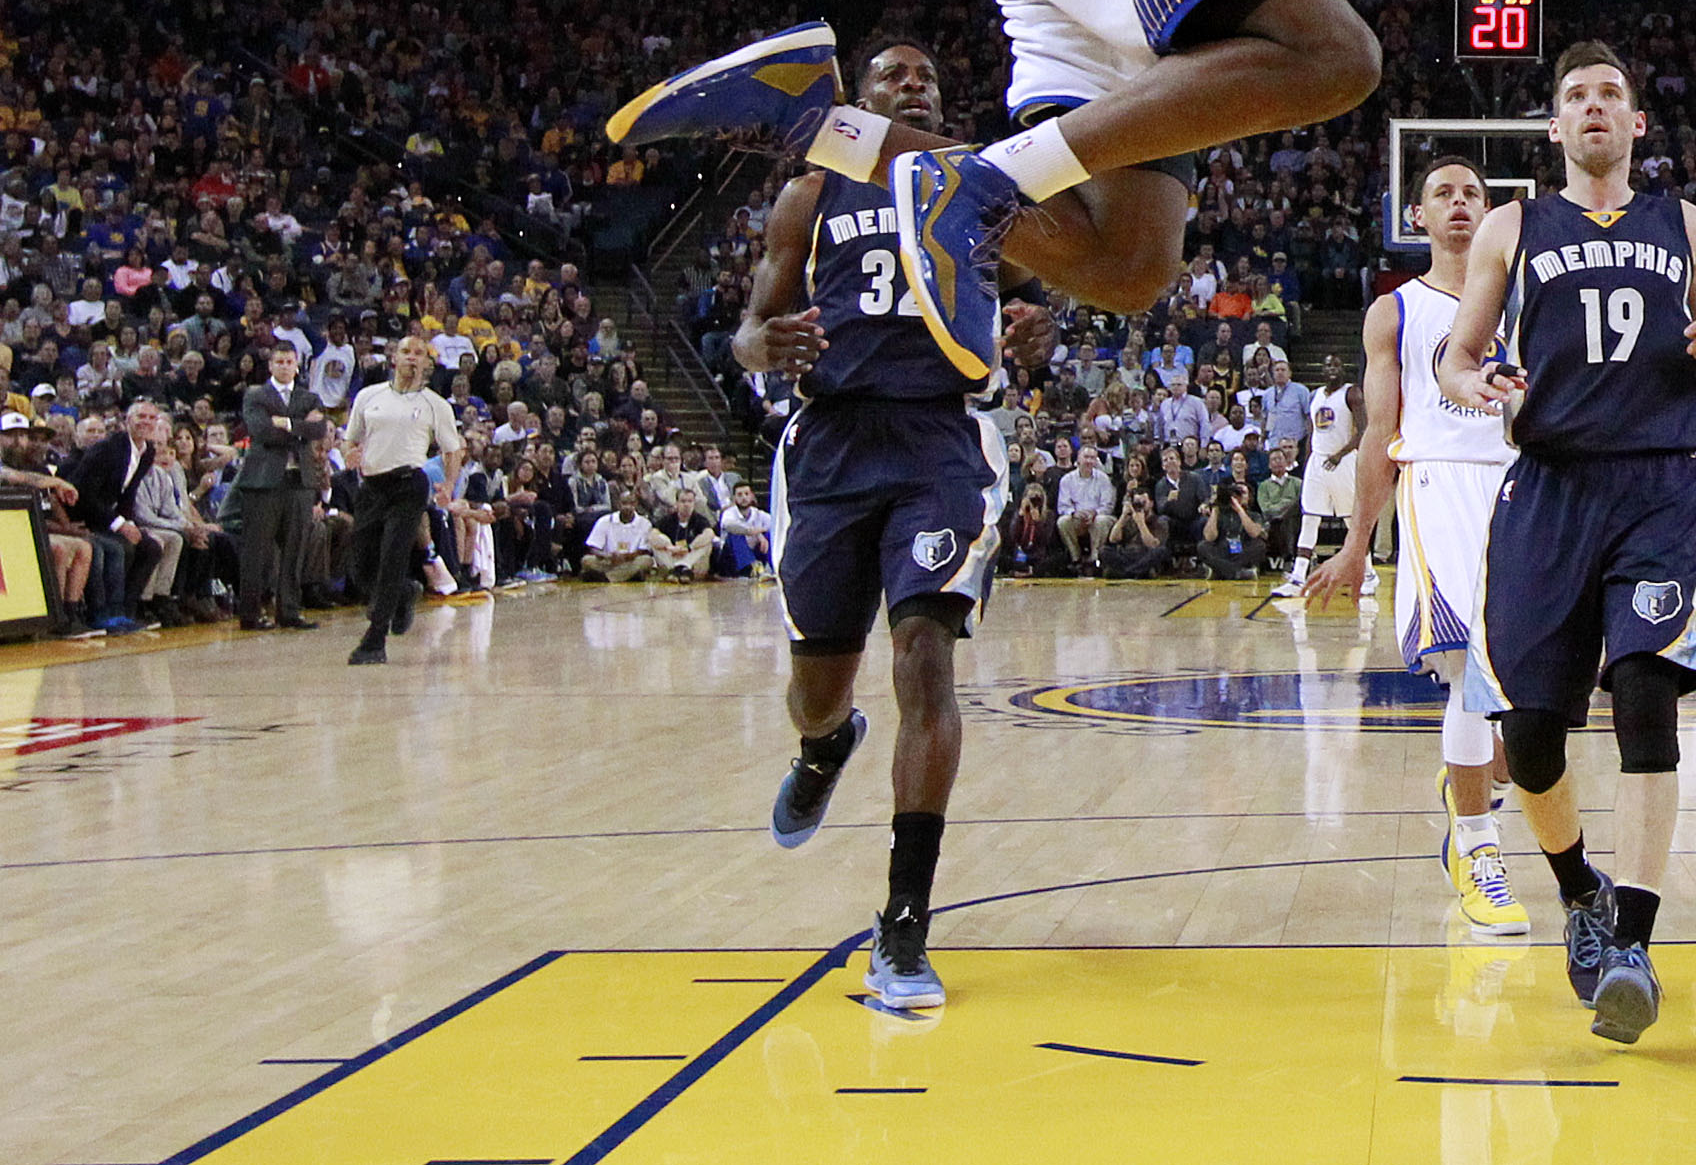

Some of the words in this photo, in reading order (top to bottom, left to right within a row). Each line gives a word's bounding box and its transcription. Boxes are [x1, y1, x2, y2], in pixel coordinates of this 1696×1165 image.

[1471, 6, 1528, 49] 20
[1530, 240, 1684, 284] MEMPHIS
[1578, 287, 1645, 364] 19
